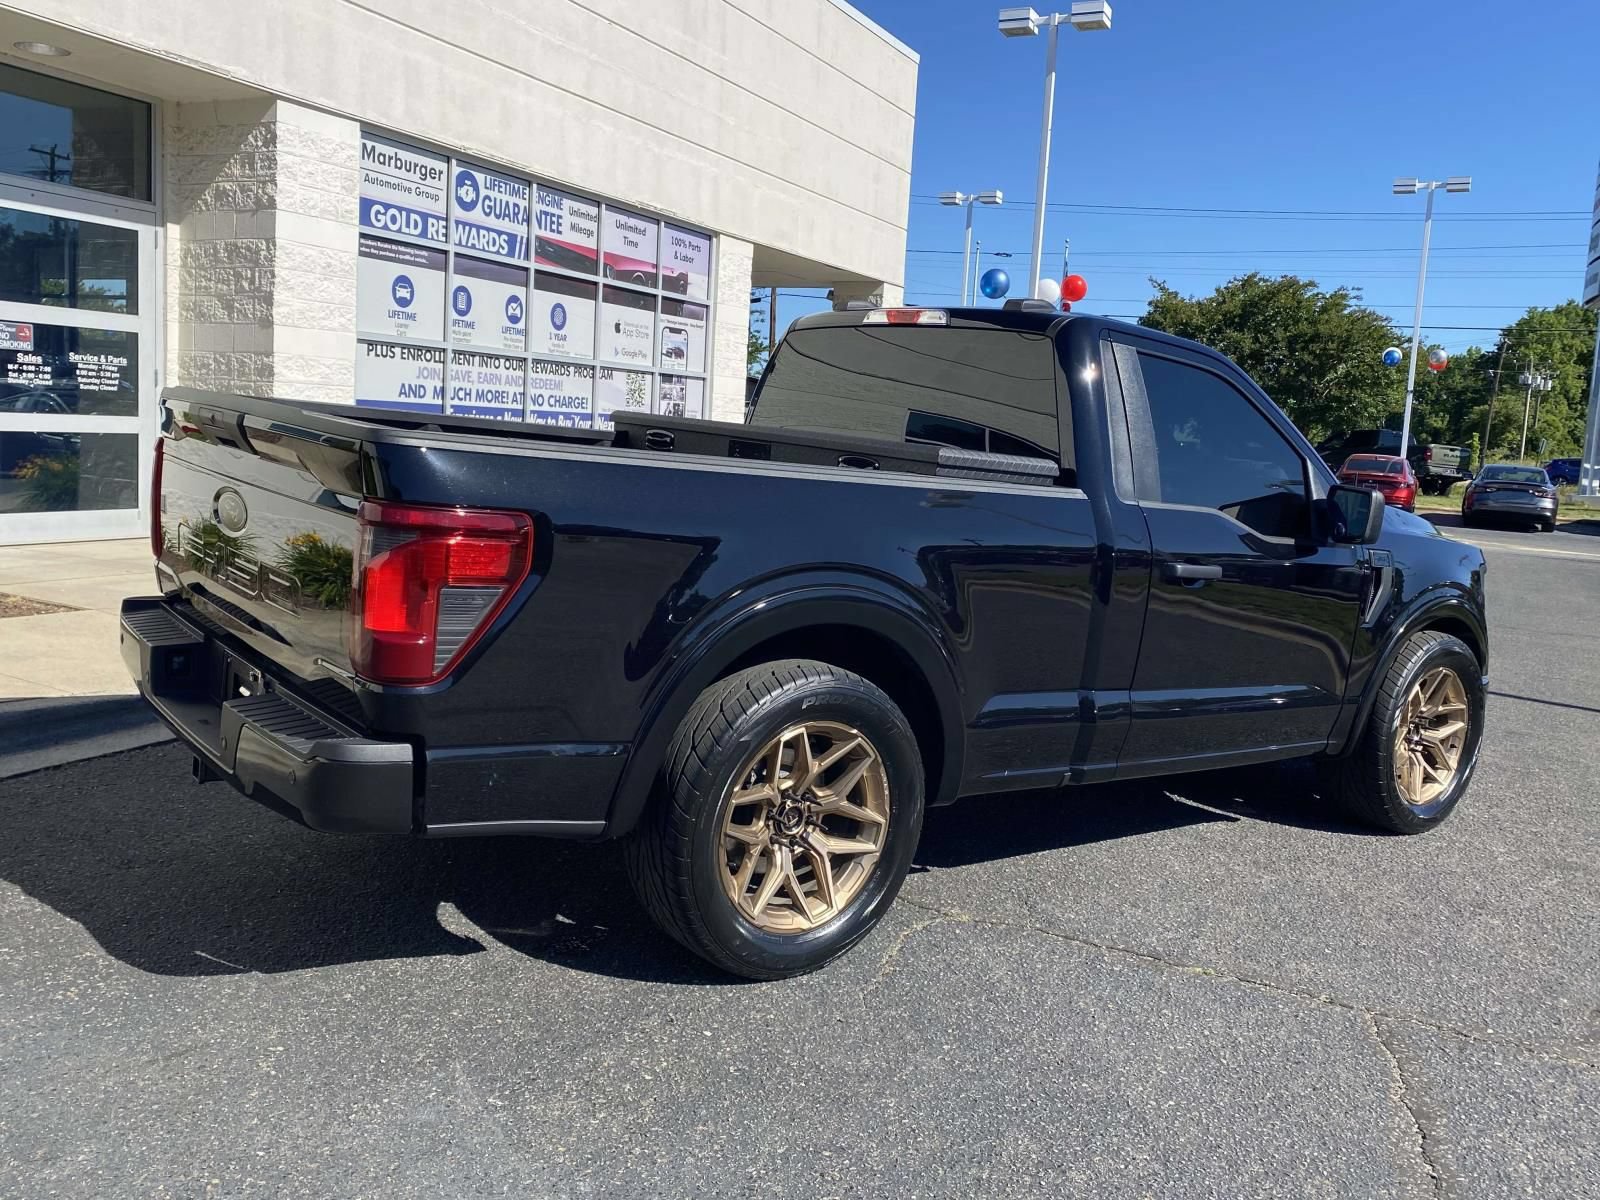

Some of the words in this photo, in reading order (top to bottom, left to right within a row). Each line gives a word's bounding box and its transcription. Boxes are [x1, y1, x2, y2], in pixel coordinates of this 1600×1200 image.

[362, 142, 443, 181] Marburger
[363, 173, 413, 194] Automotive
[415, 186, 440, 203] Group
[484, 175, 527, 201] LIFETIME
[370, 204, 422, 236] GOLD
[569, 205, 598, 223] Unlimited
[570, 221, 594, 238] Mileage
[615, 219, 646, 236] Unlimited
[623, 235, 639, 248] Time
[671, 236, 687, 249] 100%
[688, 240, 702, 252] Parts
[673, 250, 679, 259] &
[679, 252, 694, 264] Labor
[387, 308, 417, 321] LIFETIME
[501, 325, 525, 336] LIFETIME
[554, 332, 568, 342] YEAR
[622, 327, 634, 337] App
[635, 328, 650, 340] Store
[0, 340, 31, 349] SMOKING
[17, 352, 43, 363] Sales
[69, 351, 98, 362] Service
[100, 354, 106, 363] &
[107, 355, 127, 365] Parts
[367, 343, 396, 358] PLUS
[479, 355, 501, 369] INTO
[504, 359, 524, 371] OUR
[531, 361, 571, 377] REWARDS
[621, 347, 638, 359] Google
[102, 364, 118, 372] Friday
[477, 371, 501, 386] EARN
[504, 374, 524, 387] AND
[398, 383, 427, 399] AND
[475, 388, 509, 404] MORE!
[511, 391, 525, 405] AT
[530, 393, 544, 407] NO
[548, 394, 589, 409] CHARGE!
